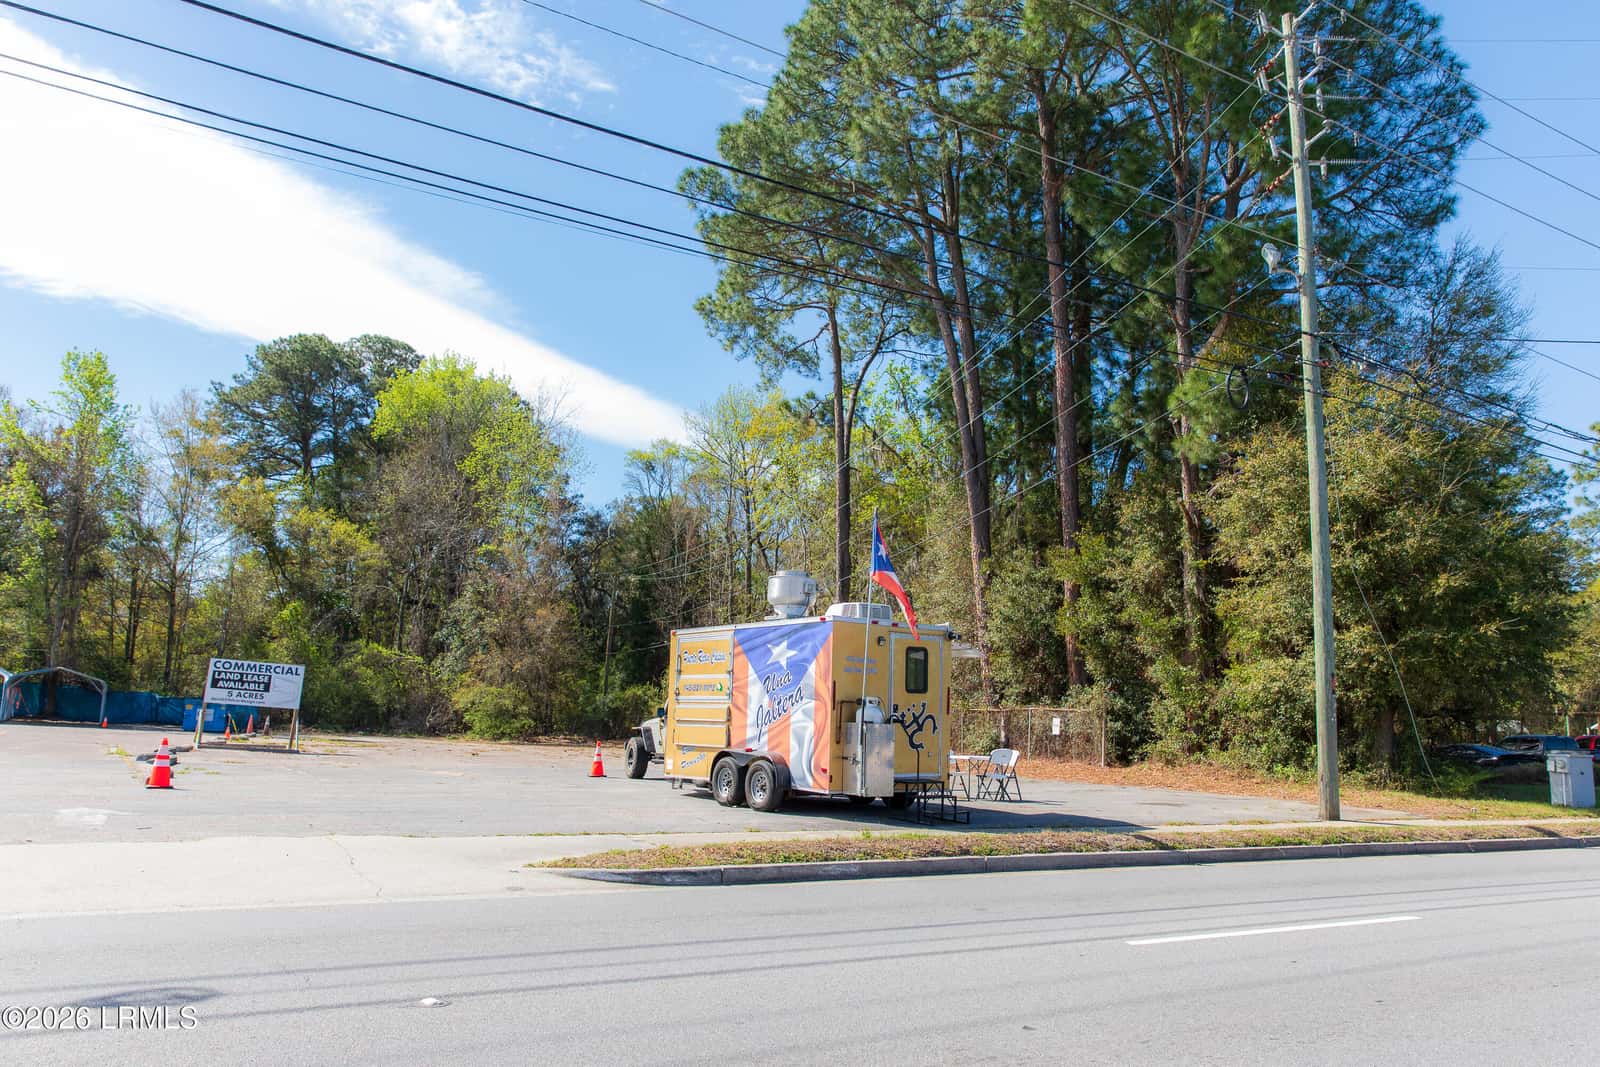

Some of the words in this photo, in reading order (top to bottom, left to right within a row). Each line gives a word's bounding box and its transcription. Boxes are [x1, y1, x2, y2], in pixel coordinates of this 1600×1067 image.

[213, 660, 301, 676] COMMERCIAL
[214, 671, 240, 680] LAND
[242, 674, 270, 683] LEASE
[762, 671, 792, 694] Una
[217, 680, 265, 691] AVAILABLE
[226, 690, 233, 698] 5
[235, 691, 265, 700] ACRES
